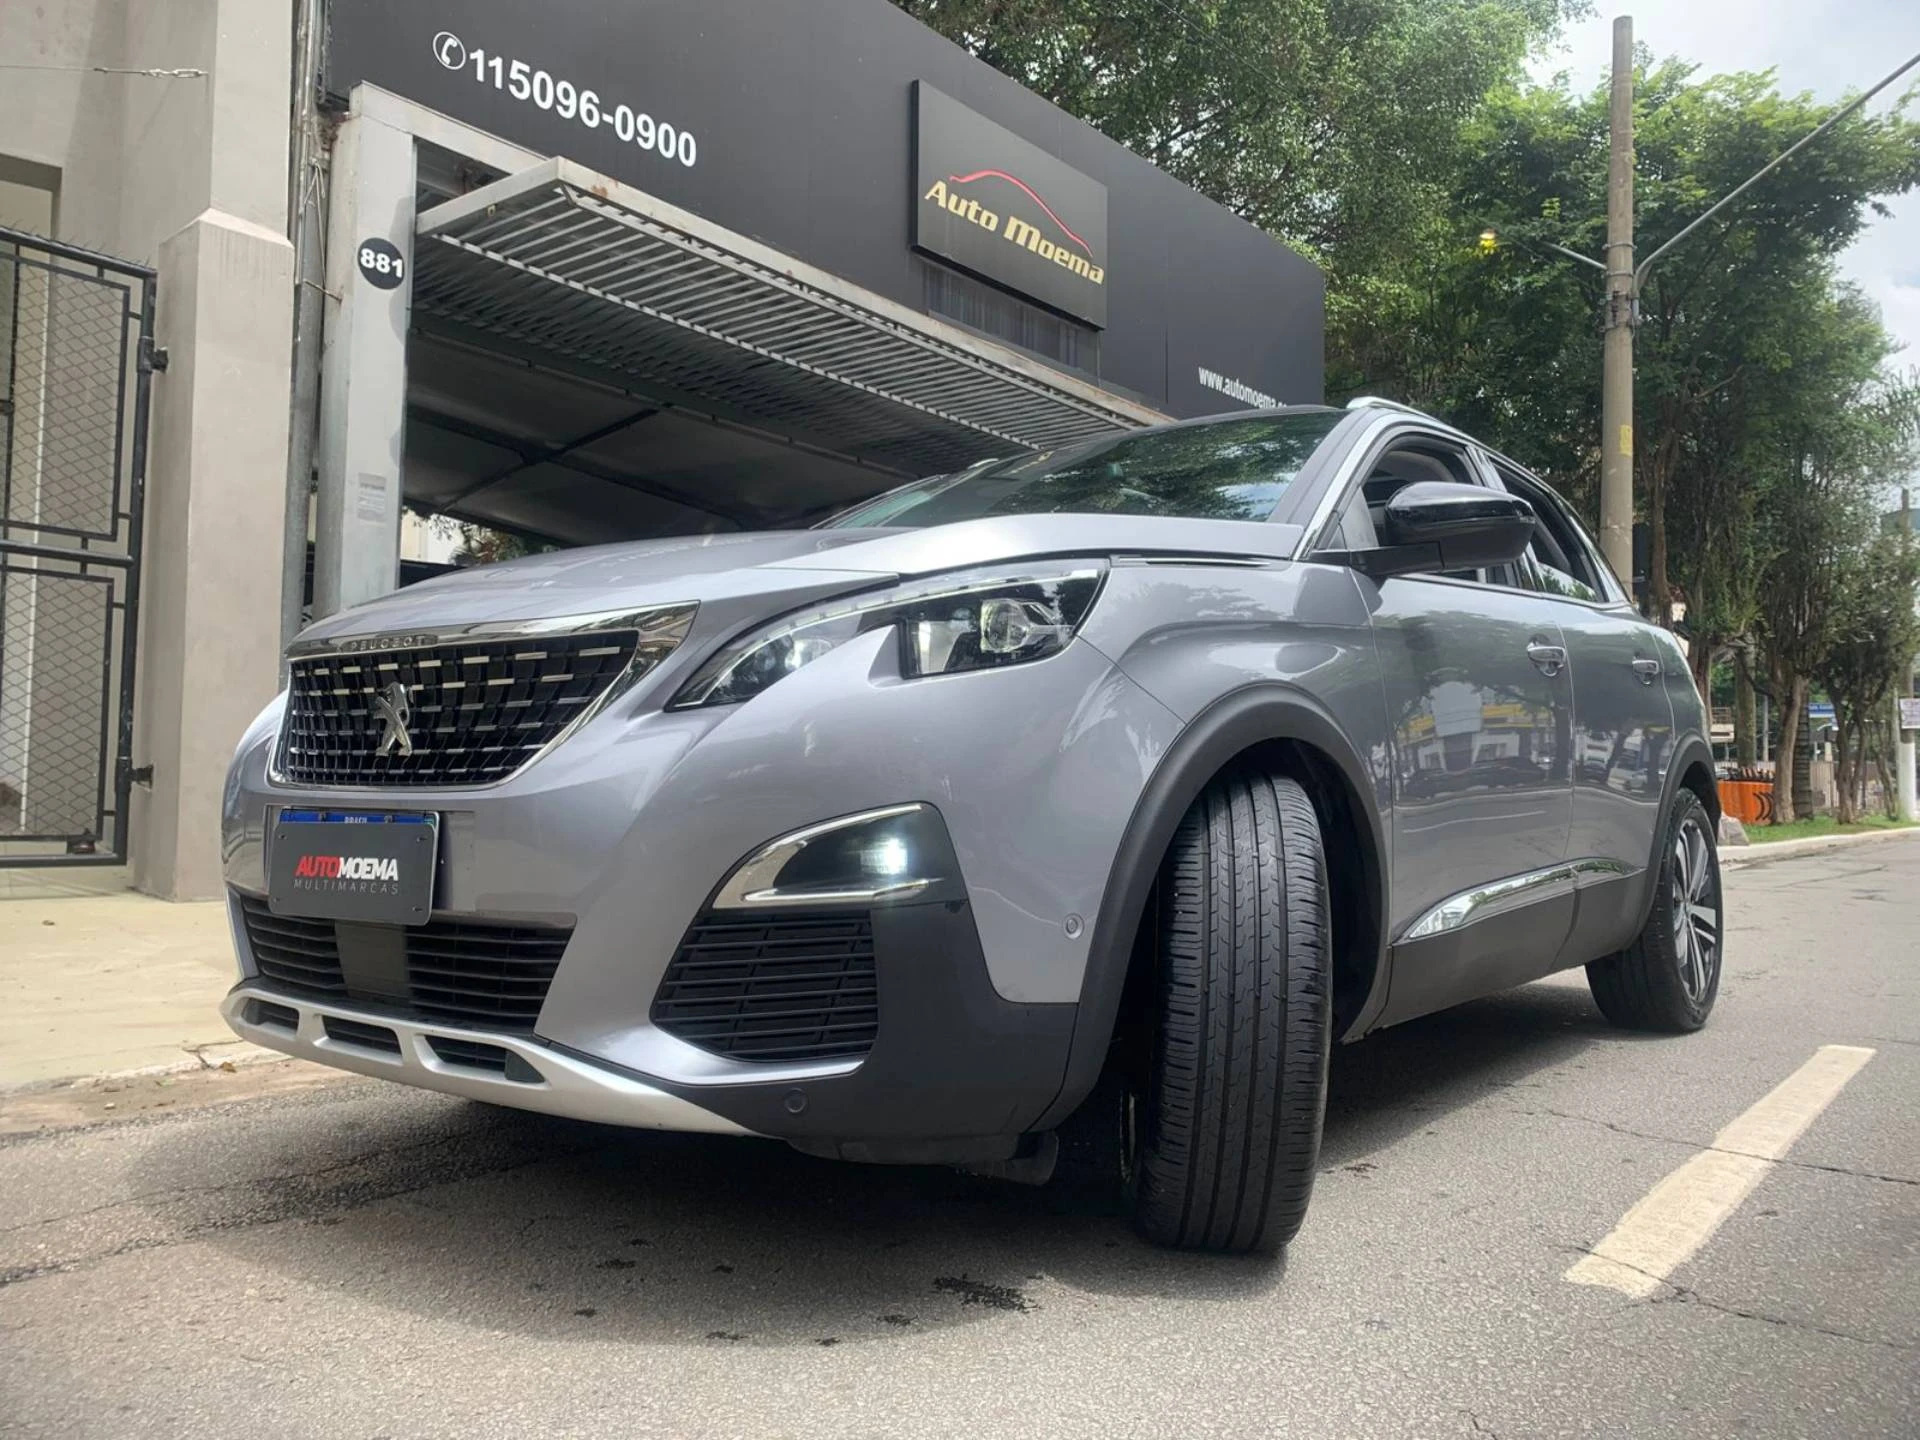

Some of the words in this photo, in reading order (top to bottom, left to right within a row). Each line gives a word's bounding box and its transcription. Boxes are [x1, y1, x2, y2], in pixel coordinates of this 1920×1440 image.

[469, 48, 697, 168] 115096-0900
[924, 179, 999, 232] Auto
[1003, 215, 1105, 285] Moema
[360, 247, 403, 278] 881
[1198, 366, 1288, 409] www.automoema
[350, 635, 426, 651] PEUGEOT
[294, 855, 399, 881] AUTOMOEMA
[293, 879, 399, 896] MULTIMARCAS
